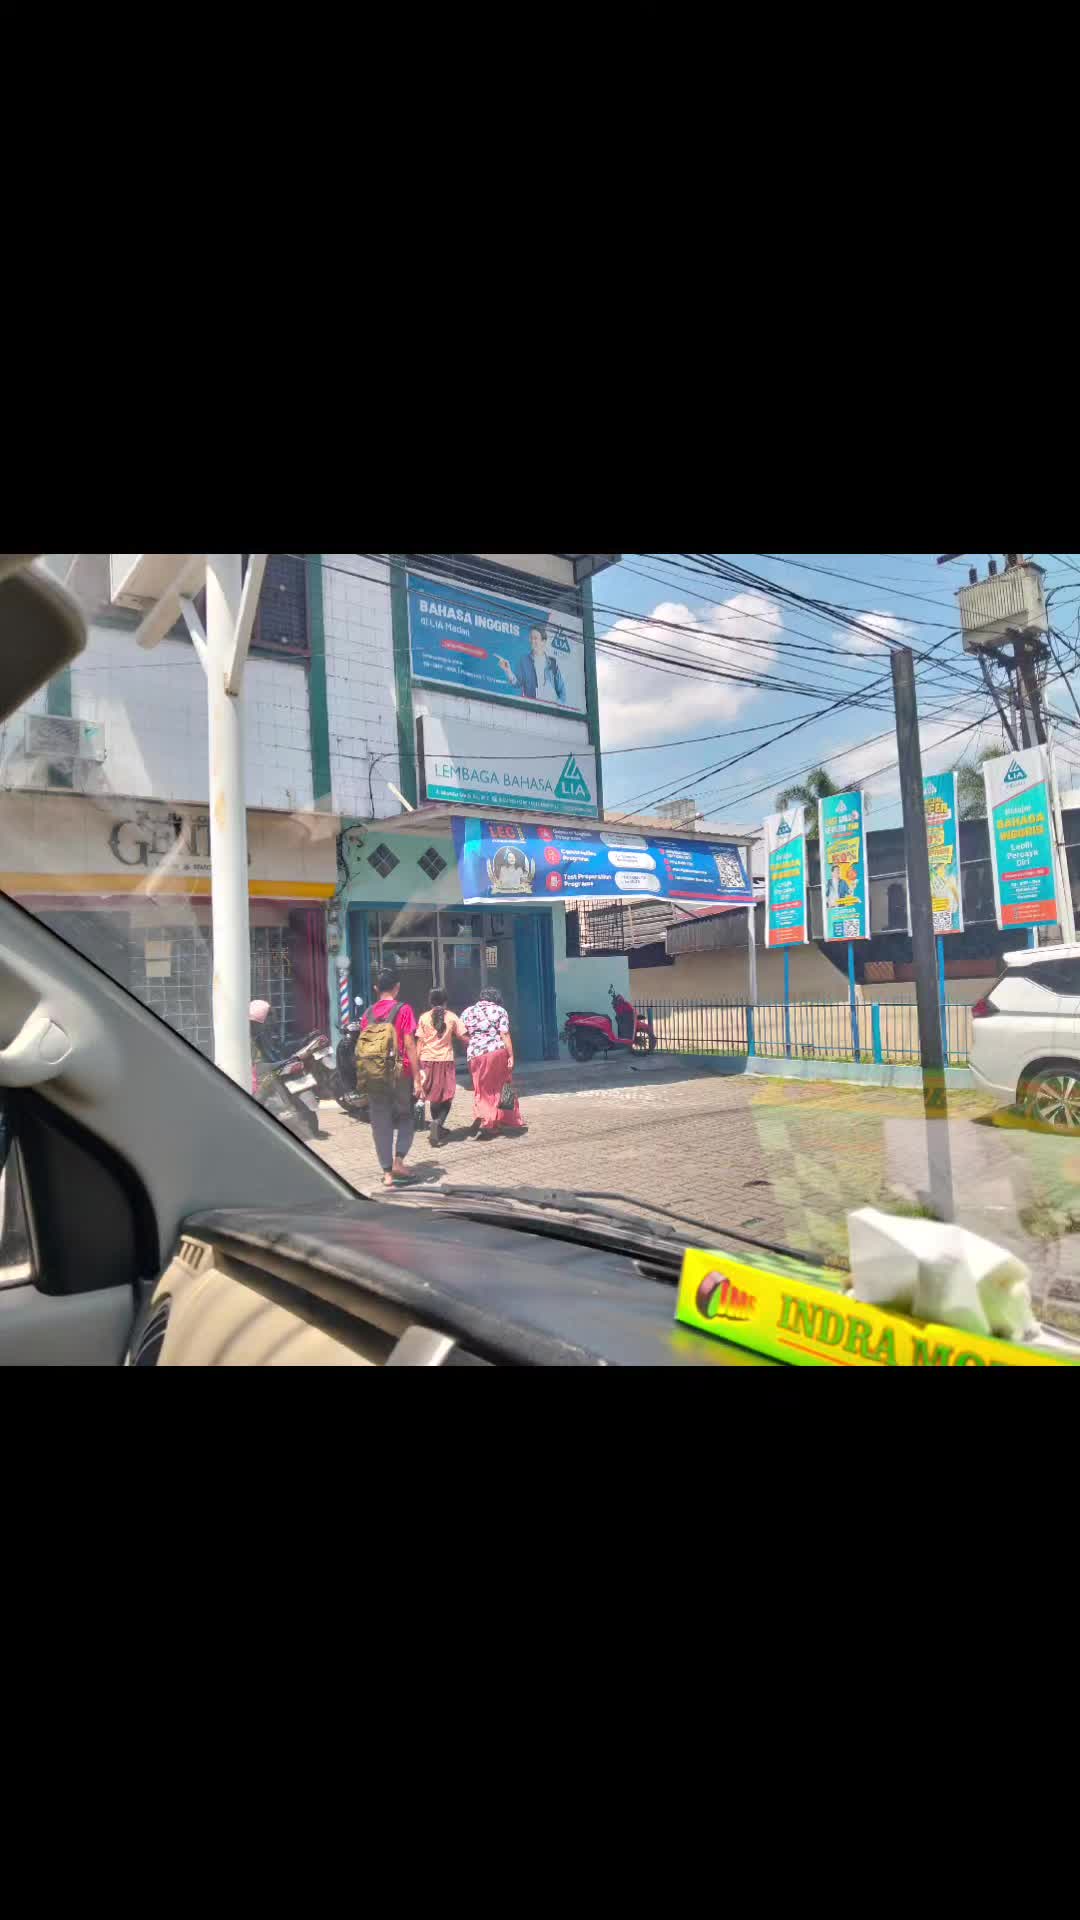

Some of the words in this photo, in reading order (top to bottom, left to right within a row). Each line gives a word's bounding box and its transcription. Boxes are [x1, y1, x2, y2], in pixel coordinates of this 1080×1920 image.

[419, 600, 472, 624] BAHASA
[474, 614, 521, 636] INGGRIS
[434, 763, 500, 785] LEMBAGA
[503, 773, 553, 793] BAHASA
[561, 781, 586, 797] LIA
[1008, 771, 1023, 780] LIA
[776, 1293, 897, 1366] INDRA
